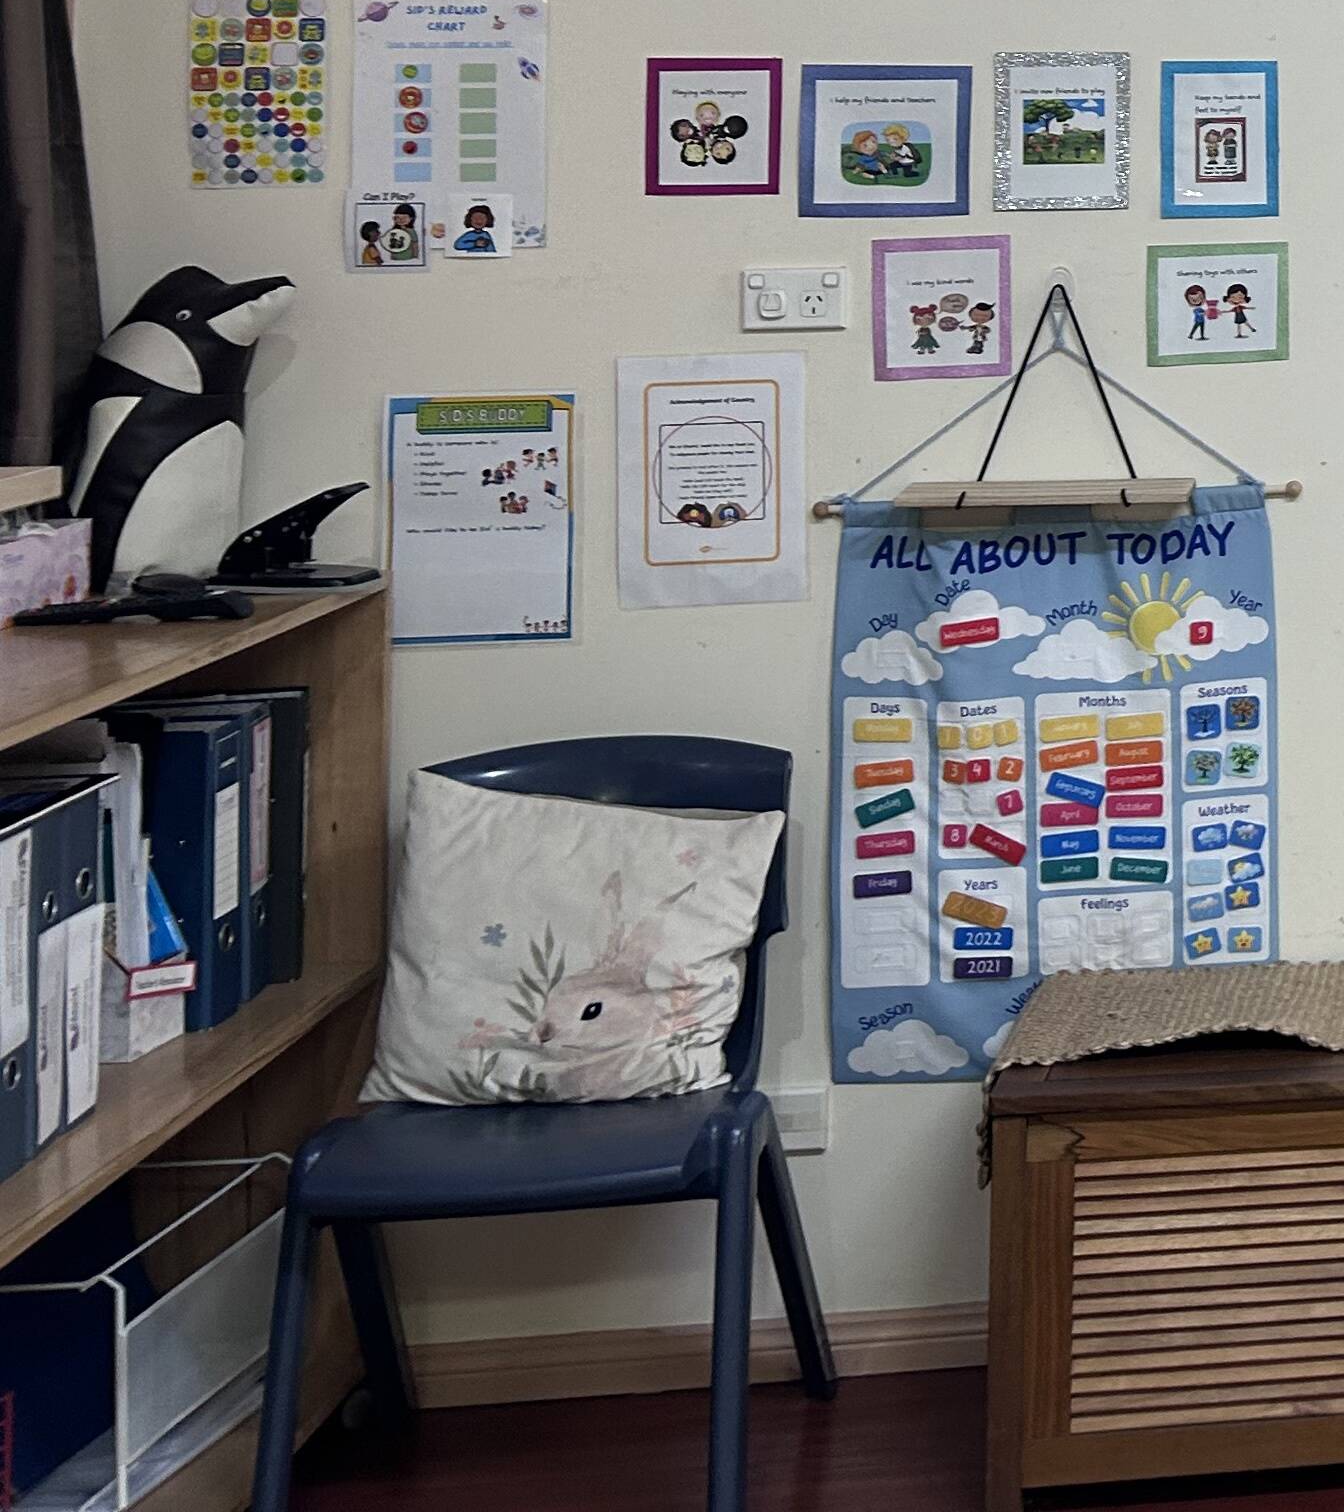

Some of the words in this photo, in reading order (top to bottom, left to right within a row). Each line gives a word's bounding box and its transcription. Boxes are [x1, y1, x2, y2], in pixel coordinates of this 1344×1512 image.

[427, 21, 466, 31] CHART
[870, 534, 932, 570] ALL
[950, 531, 1087, 575] ABOUT
[1106, 521, 1235, 567] TODAY
[935, 579, 970, 608] Date
[1229, 589, 1262, 612] Year
[1046, 599, 1098, 626] Month
[869, 612, 899, 633] Day
[1198, 685, 1249, 699] Seasons
[870, 702, 900, 716] Days
[1078, 696, 1127, 708] Months
[960, 704, 997, 717] Dates
[1110, 772, 1158, 786] September
[1198, 803, 1251, 817] Weather
[1117, 862, 1162, 875] December
[964, 879, 998, 890] Years
[1080, 898, 1129, 911] Feelings
[965, 932, 1002, 946] 2022
[967, 960, 1000, 974] 2021
[858, 1002, 914, 1031] Season
